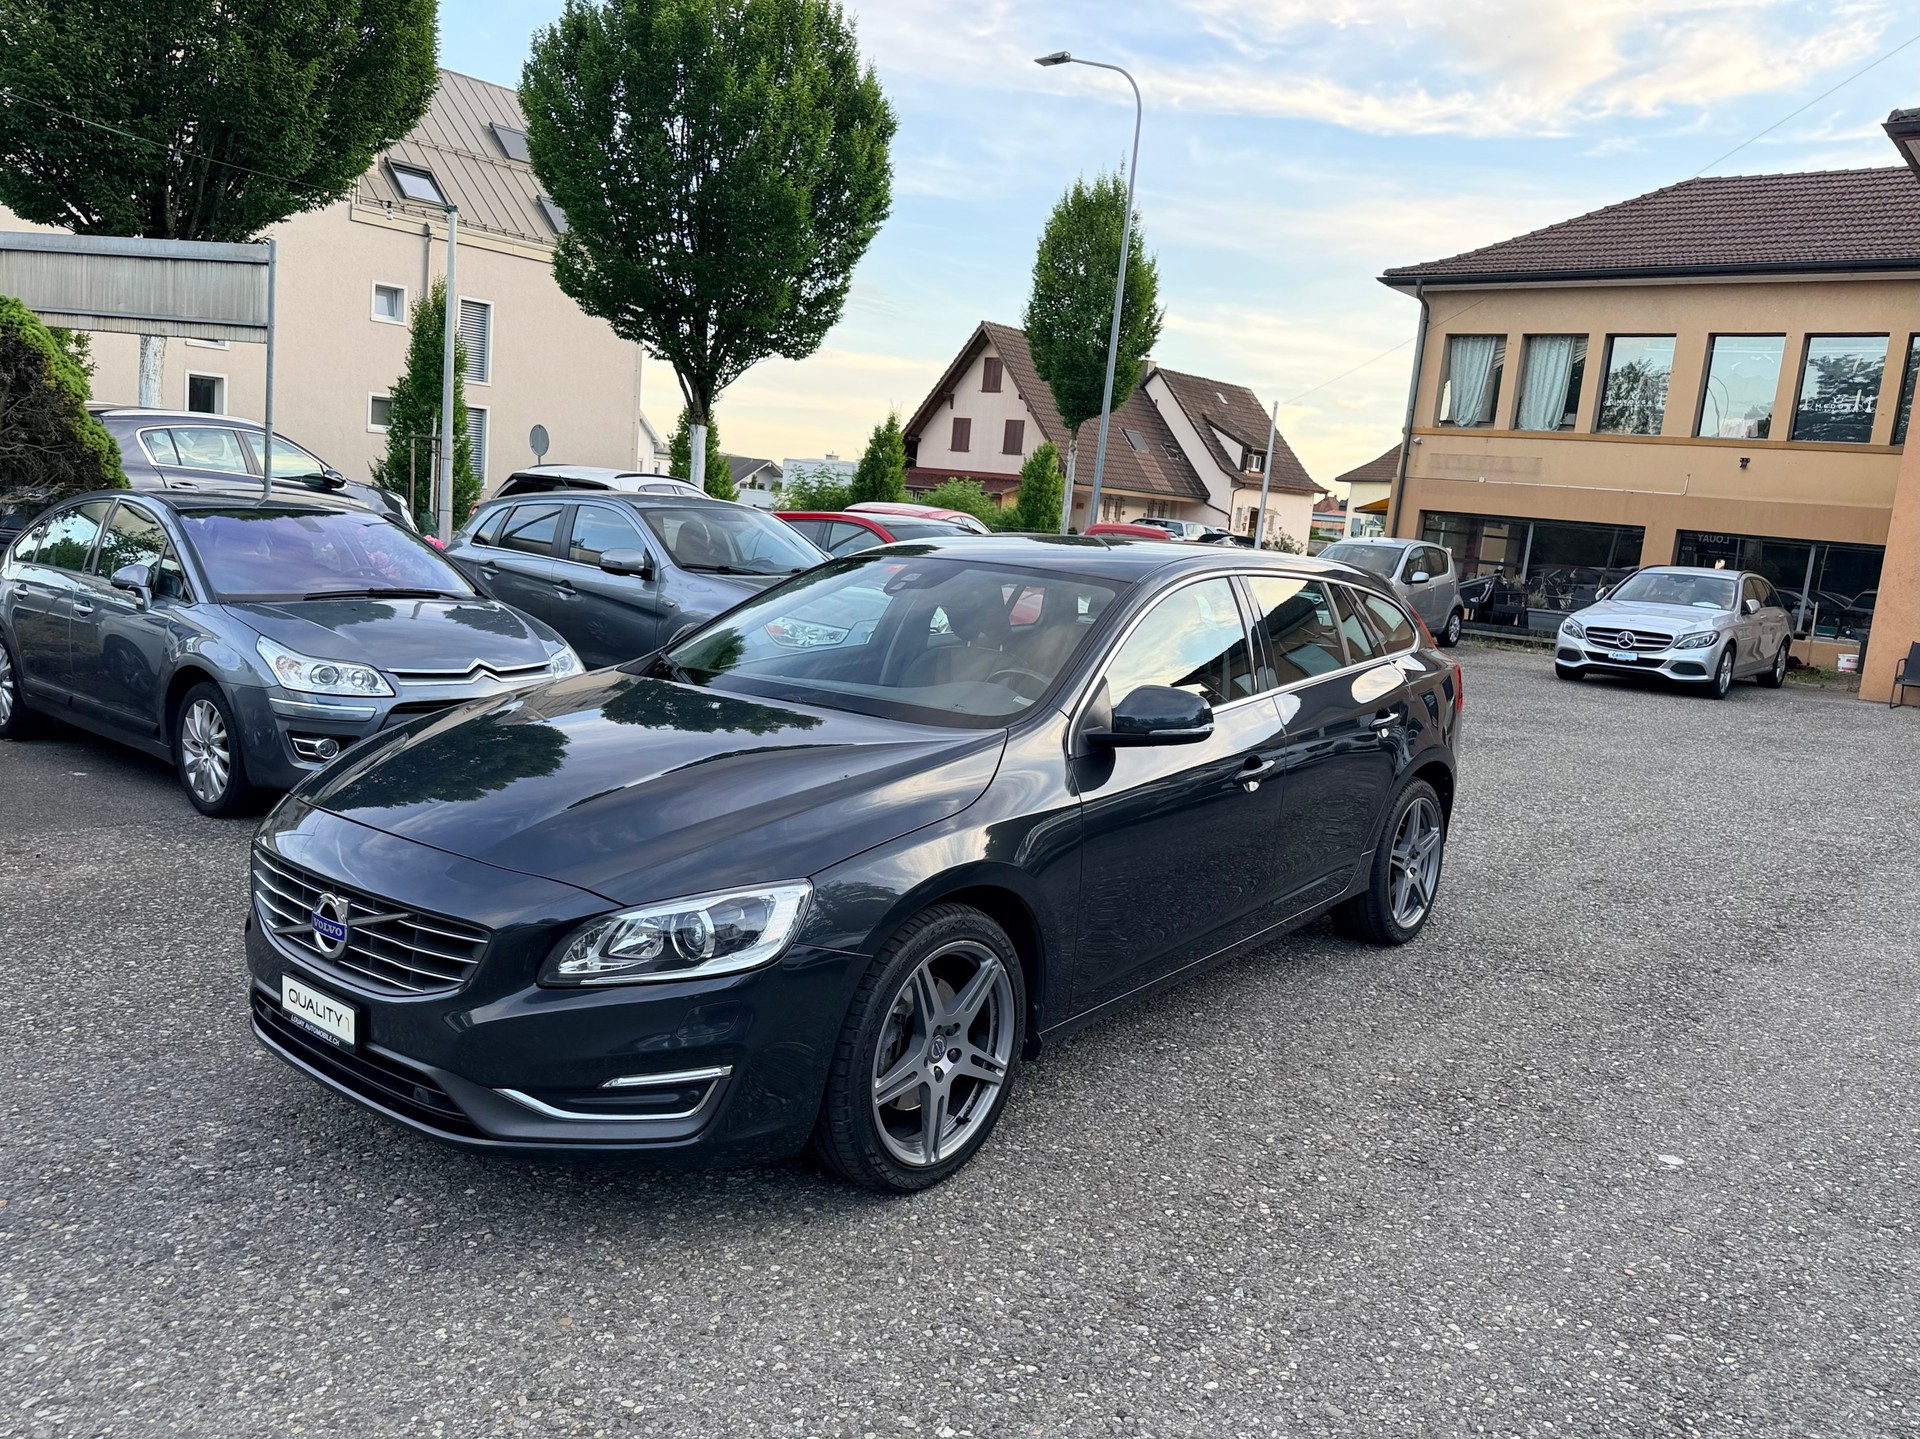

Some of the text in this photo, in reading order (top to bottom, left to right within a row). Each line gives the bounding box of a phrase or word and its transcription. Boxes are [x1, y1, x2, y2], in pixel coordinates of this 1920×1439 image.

[313, 917, 343, 937] VOLVO
[288, 988, 350, 1033] QUALITY 1
